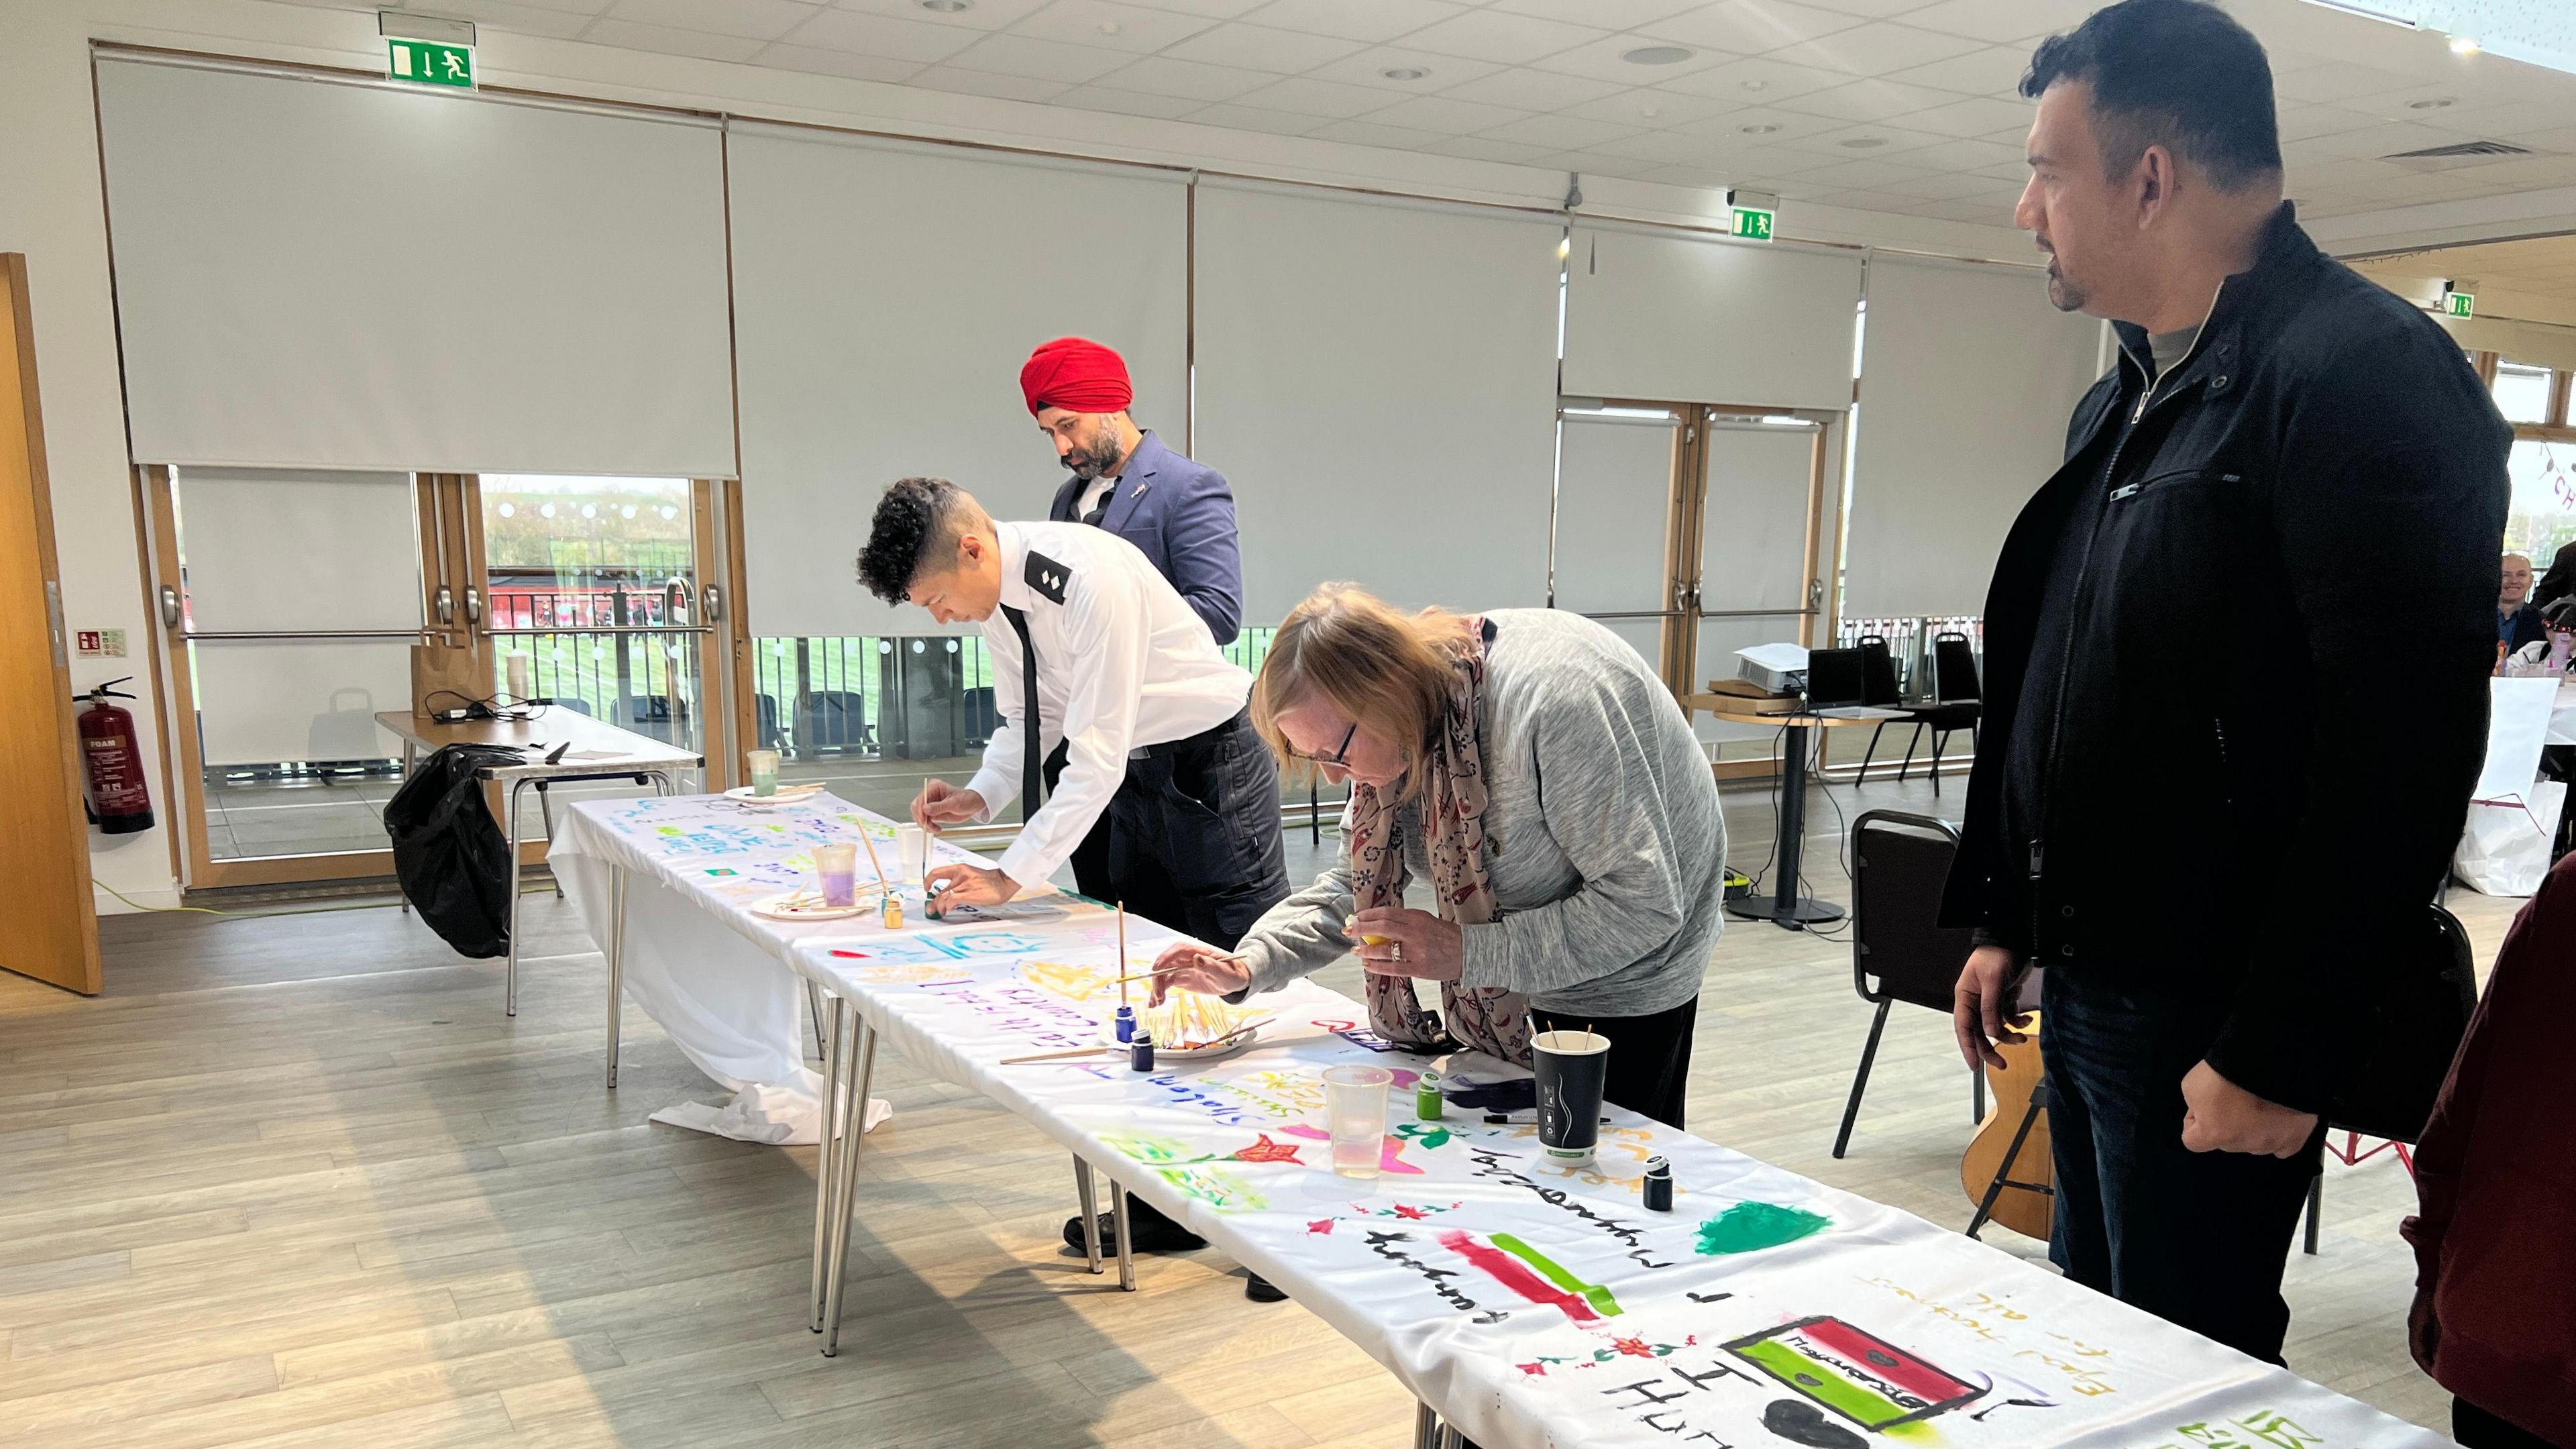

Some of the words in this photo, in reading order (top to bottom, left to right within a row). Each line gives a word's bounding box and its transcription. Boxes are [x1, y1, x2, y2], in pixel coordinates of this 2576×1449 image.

[989, 1018, 1081, 1047] Earth
[1969, 1293, 2028, 1321] all
[2045, 1331, 2110, 1360] for
[2014, 1351, 2117, 1397] Equal
